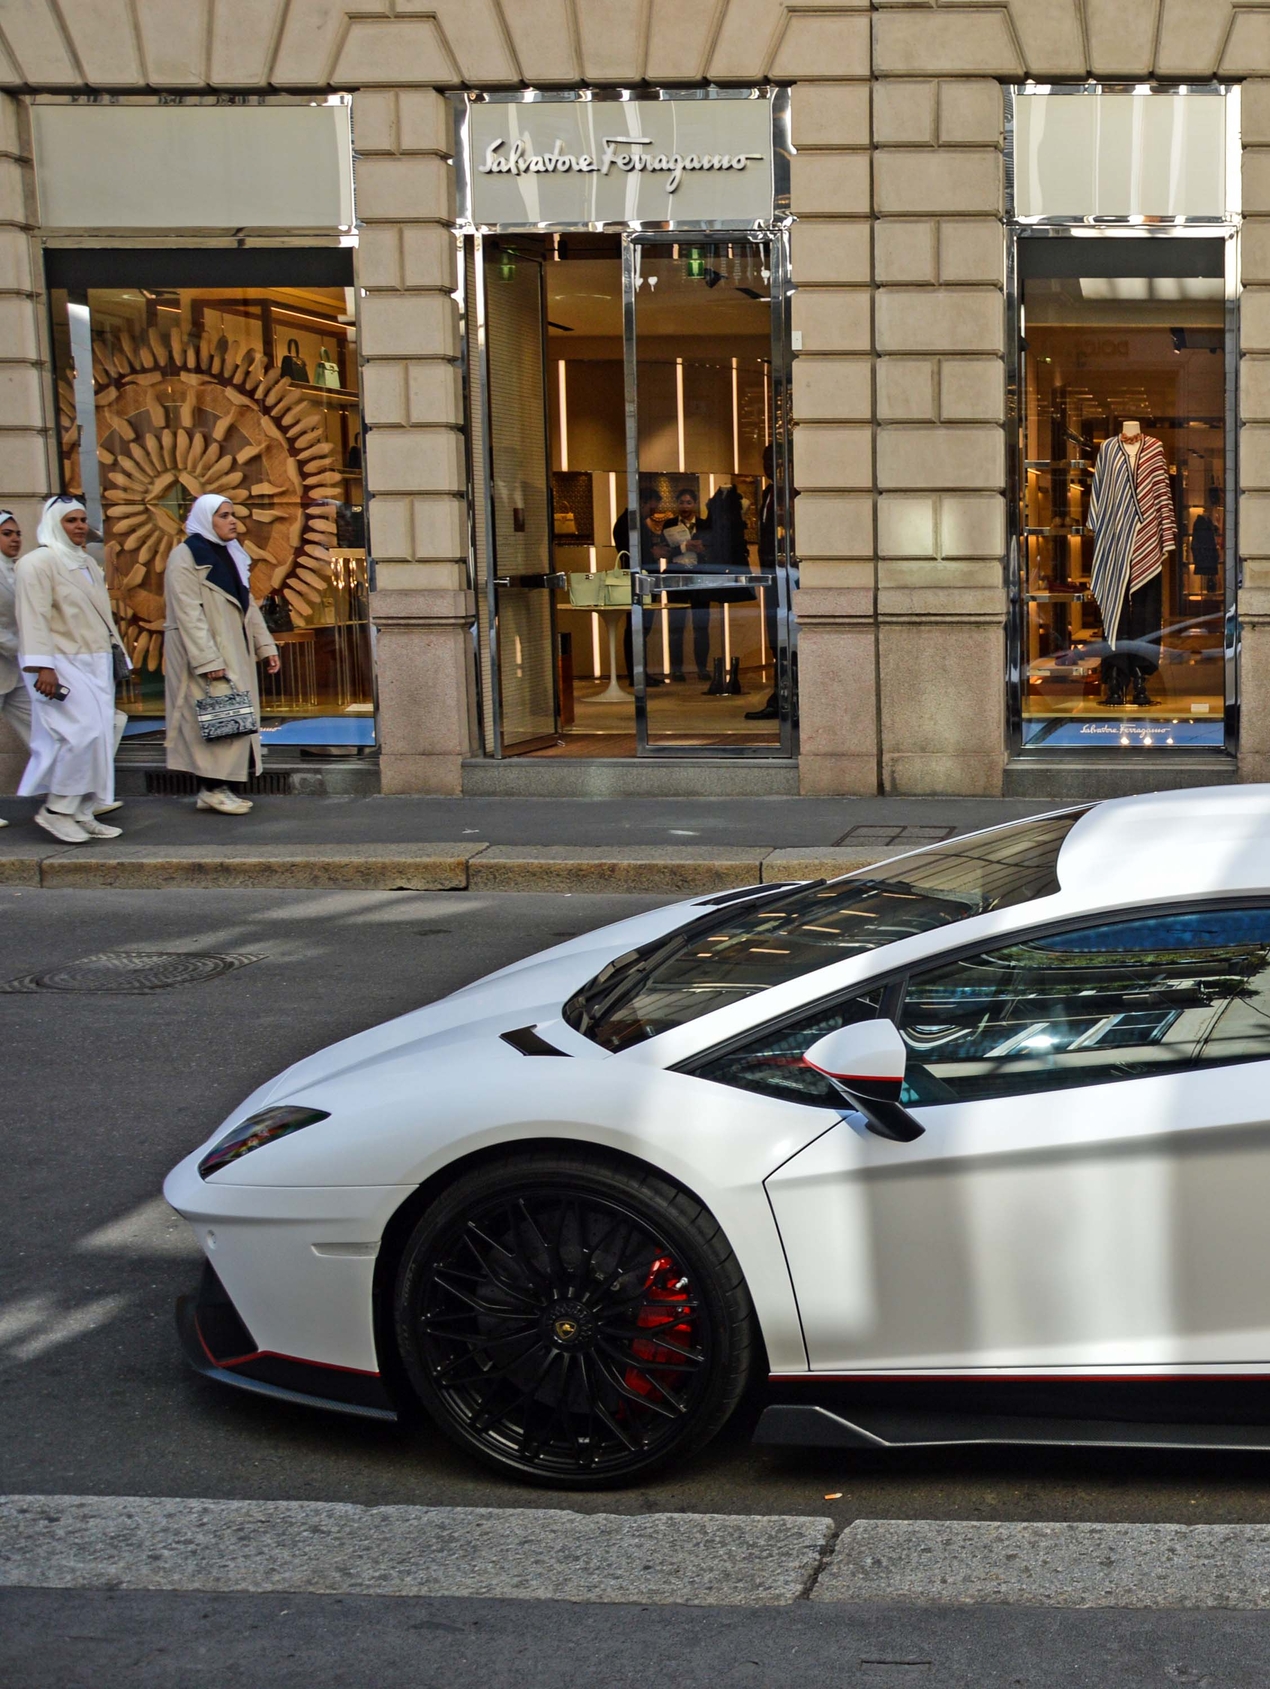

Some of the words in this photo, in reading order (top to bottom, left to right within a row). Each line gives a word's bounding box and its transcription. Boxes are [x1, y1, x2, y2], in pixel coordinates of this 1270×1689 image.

[479, 138, 600, 174] Salvatore
[601, 136, 764, 193] Ferragamo
[1080, 724, 1119, 734] Salvatore
[1120, 724, 1171, 738] Ferragamo
